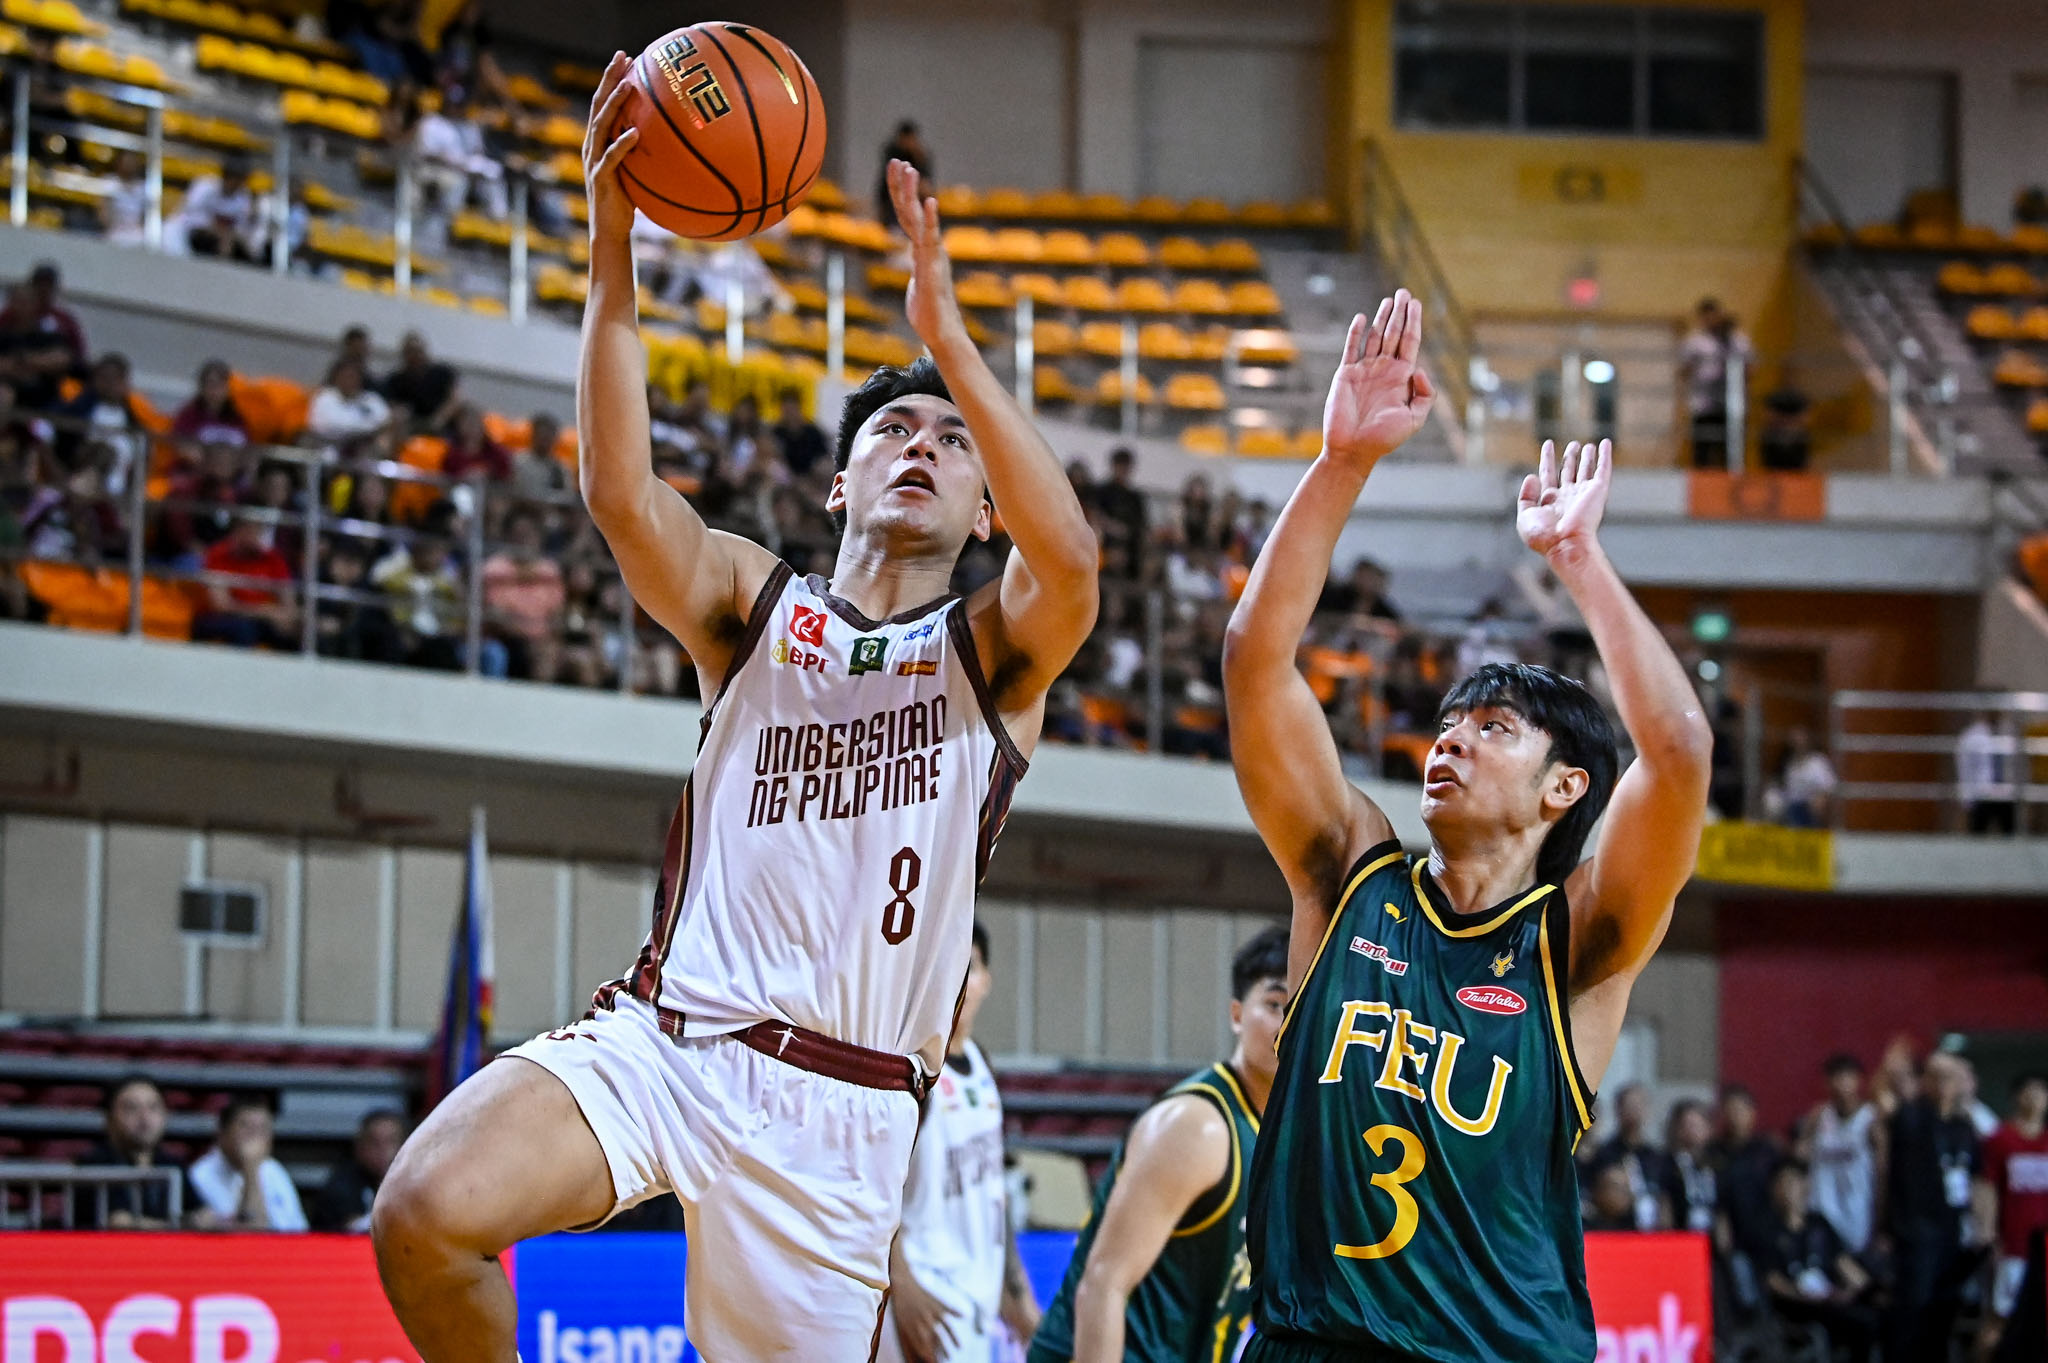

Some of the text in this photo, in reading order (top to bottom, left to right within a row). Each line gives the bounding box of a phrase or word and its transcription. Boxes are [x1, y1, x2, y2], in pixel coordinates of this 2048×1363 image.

[659, 35, 732, 124] ELITE
[789, 645, 826, 673] BPI
[755, 694, 947, 776] UNIBERSIDAD
[747, 747, 942, 828] NG PILIPINAS
[881, 846, 921, 945] 8
[1318, 1000, 1513, 1137] FEU
[1333, 1124, 1426, 1260] 3
[1597, 1291, 1698, 1363] ank
